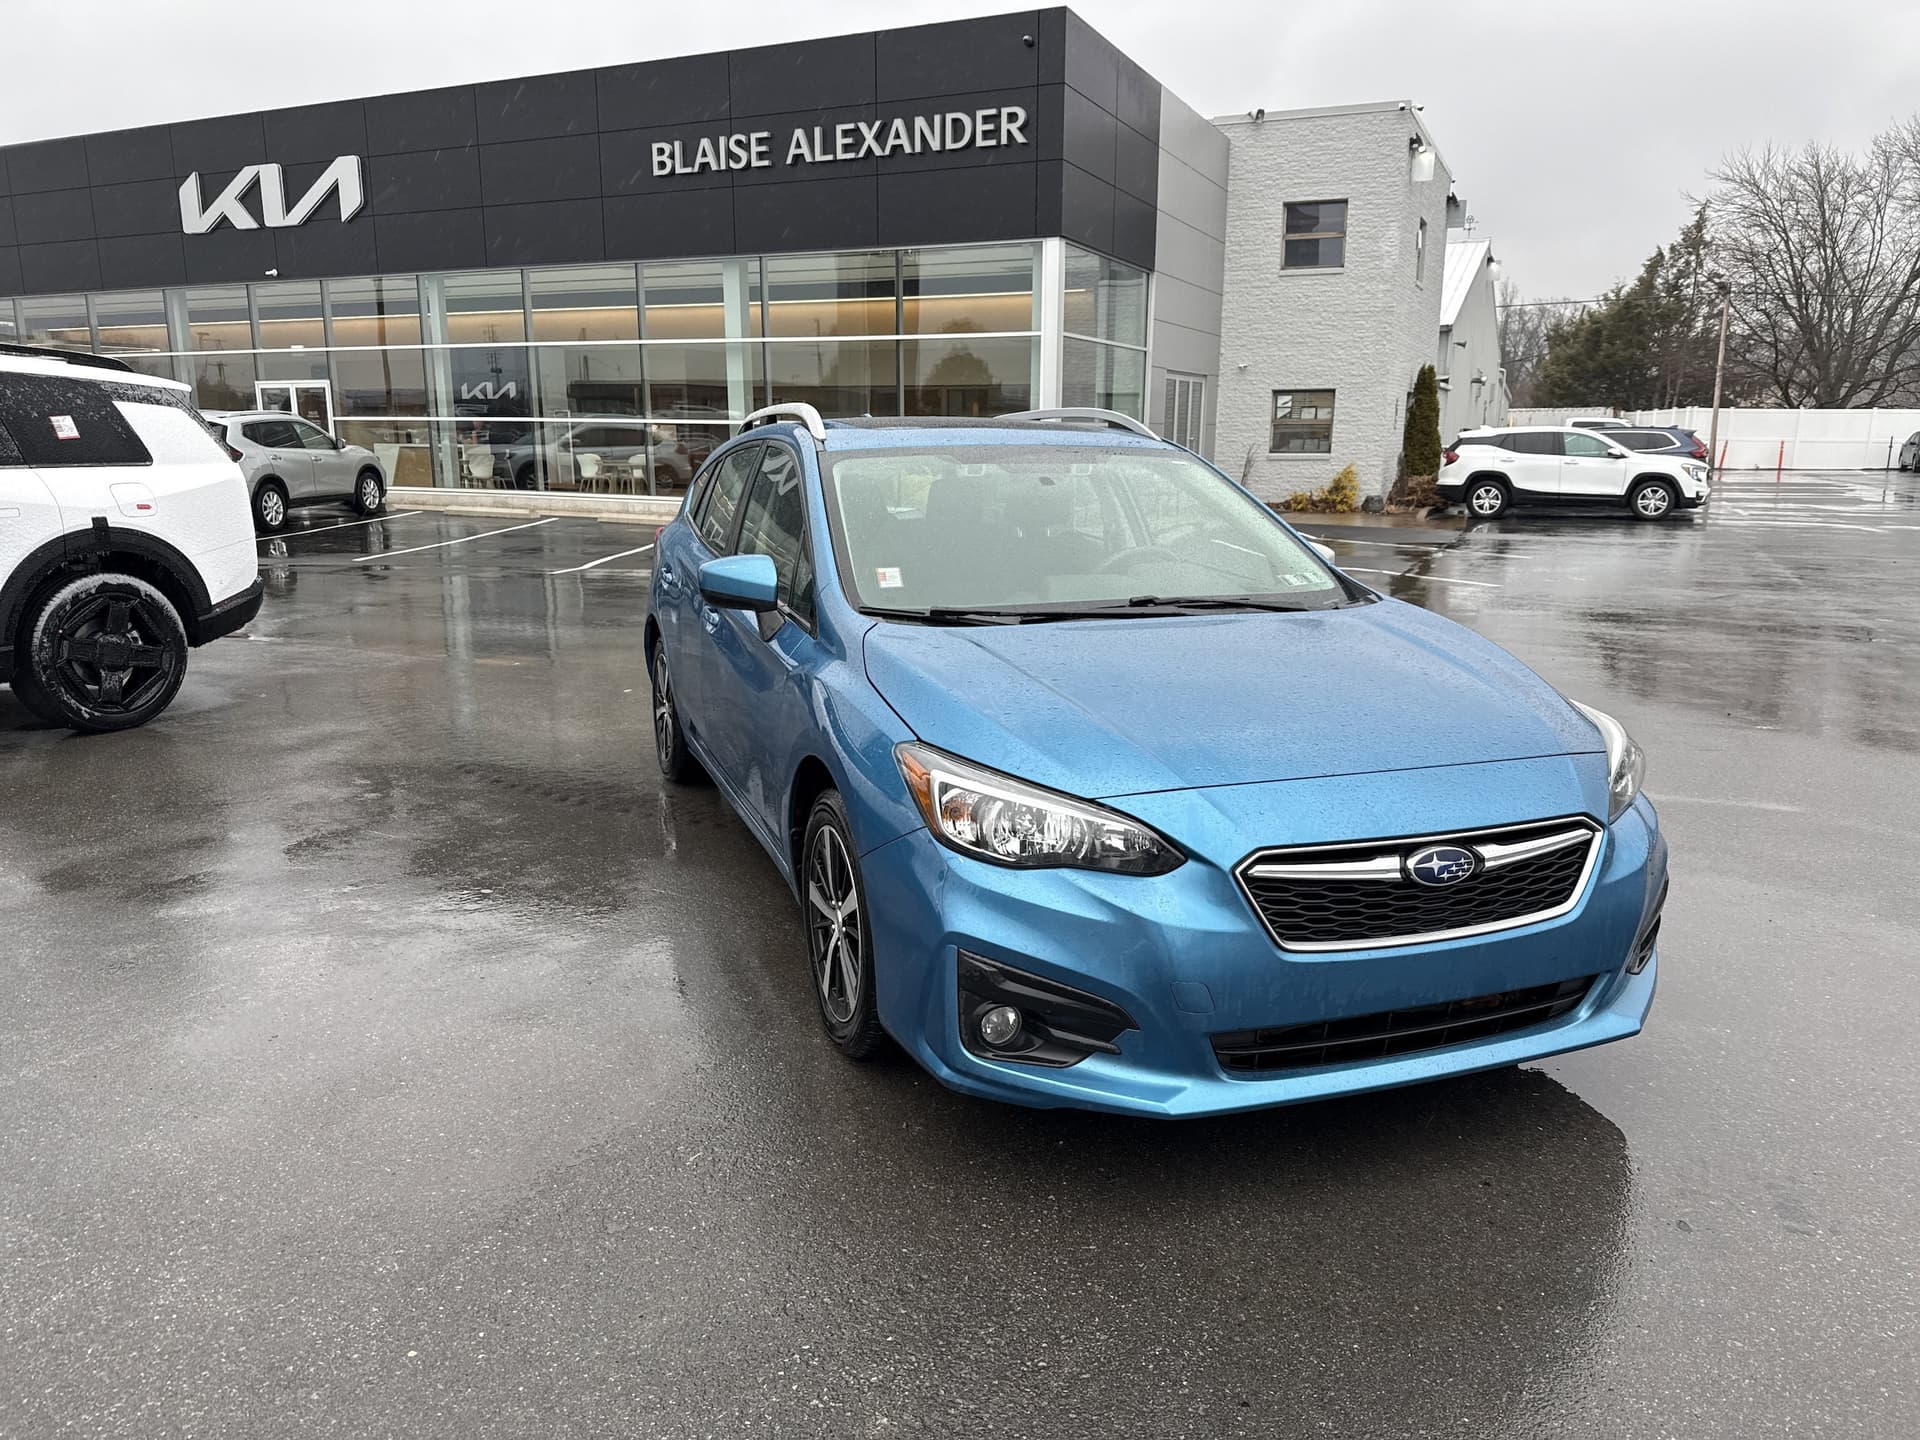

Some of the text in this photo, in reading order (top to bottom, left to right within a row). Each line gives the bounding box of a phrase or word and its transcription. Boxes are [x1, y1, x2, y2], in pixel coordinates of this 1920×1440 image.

[651, 106, 1028, 177] BLAISE ALEXANDER
[179, 155, 364, 235] KIA
[461, 381, 517, 400] KIA
